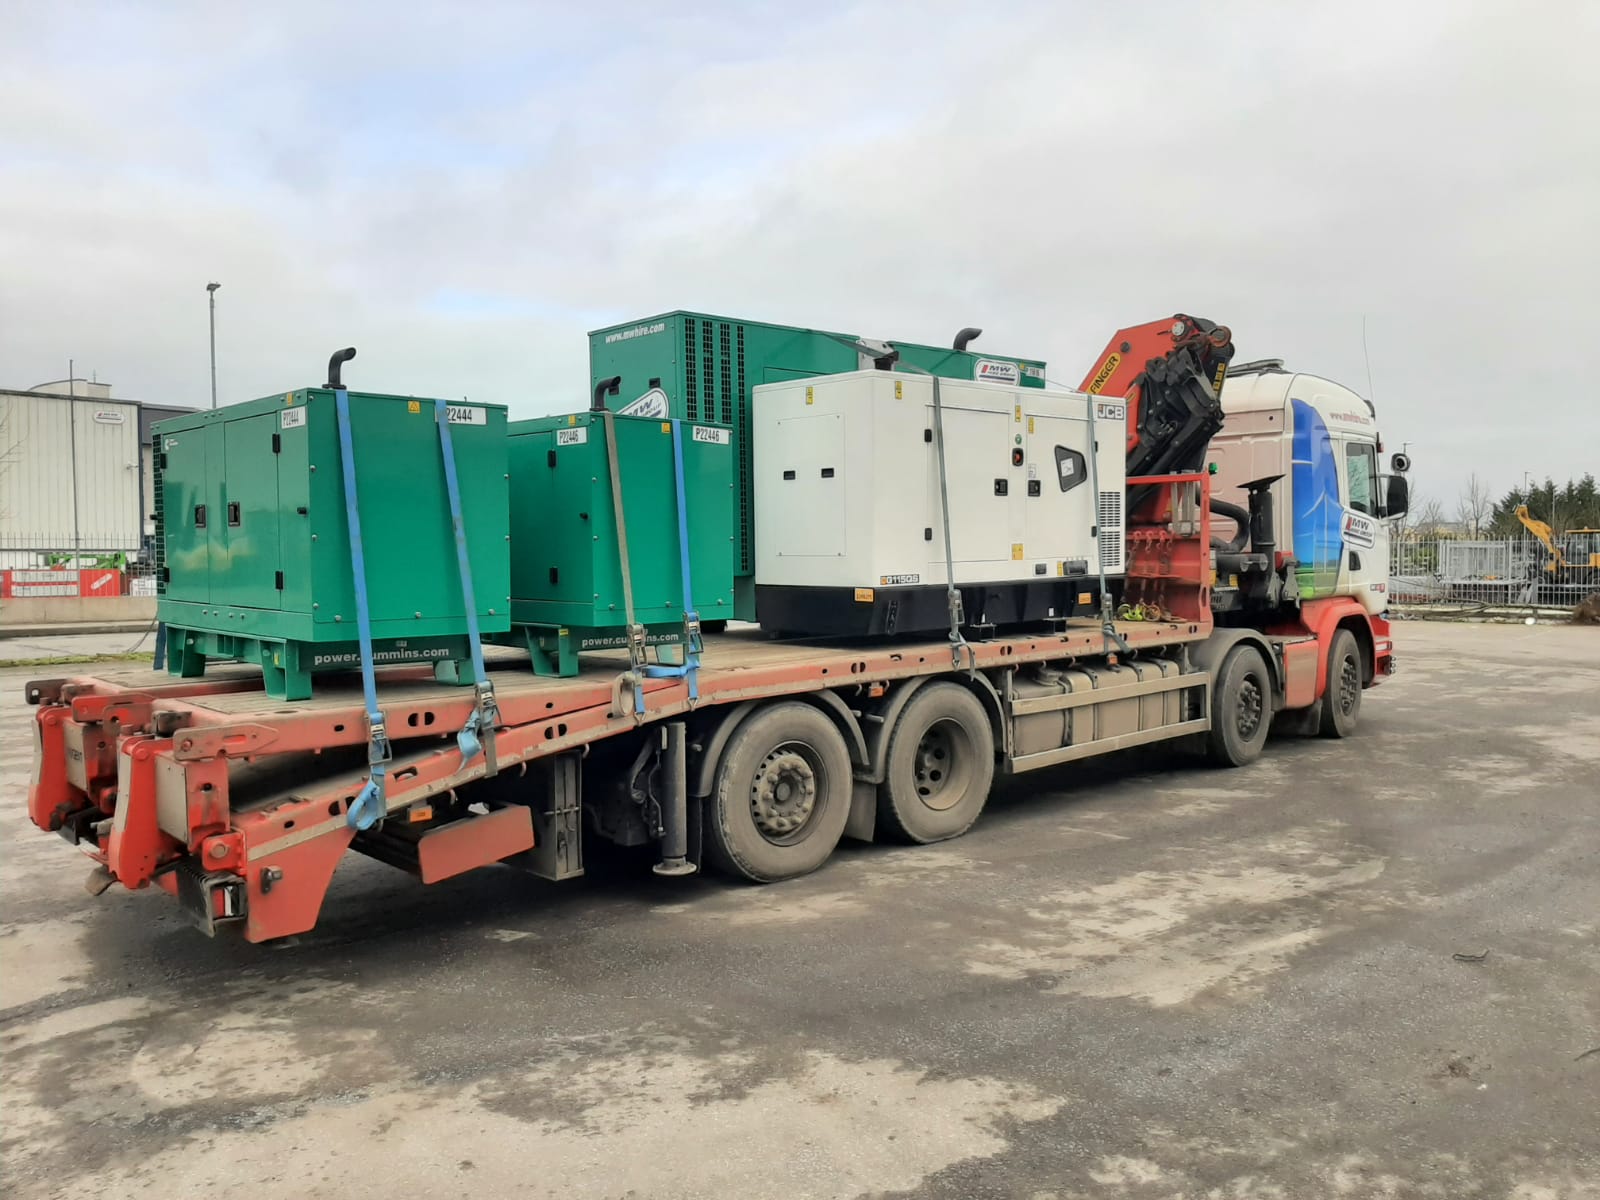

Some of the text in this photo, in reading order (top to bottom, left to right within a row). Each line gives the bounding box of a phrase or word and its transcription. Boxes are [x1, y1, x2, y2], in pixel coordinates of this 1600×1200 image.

[605, 323, 665, 344] www.mwhire.com
[446, 407, 472, 422] 22444
[1098, 404, 1124, 420] JCB
[559, 430, 578, 444] P22446
[695, 427, 720, 442] P22446
[582, 633, 679, 648] power.cuns.com
[314, 648, 450, 666] power.ummins.com
